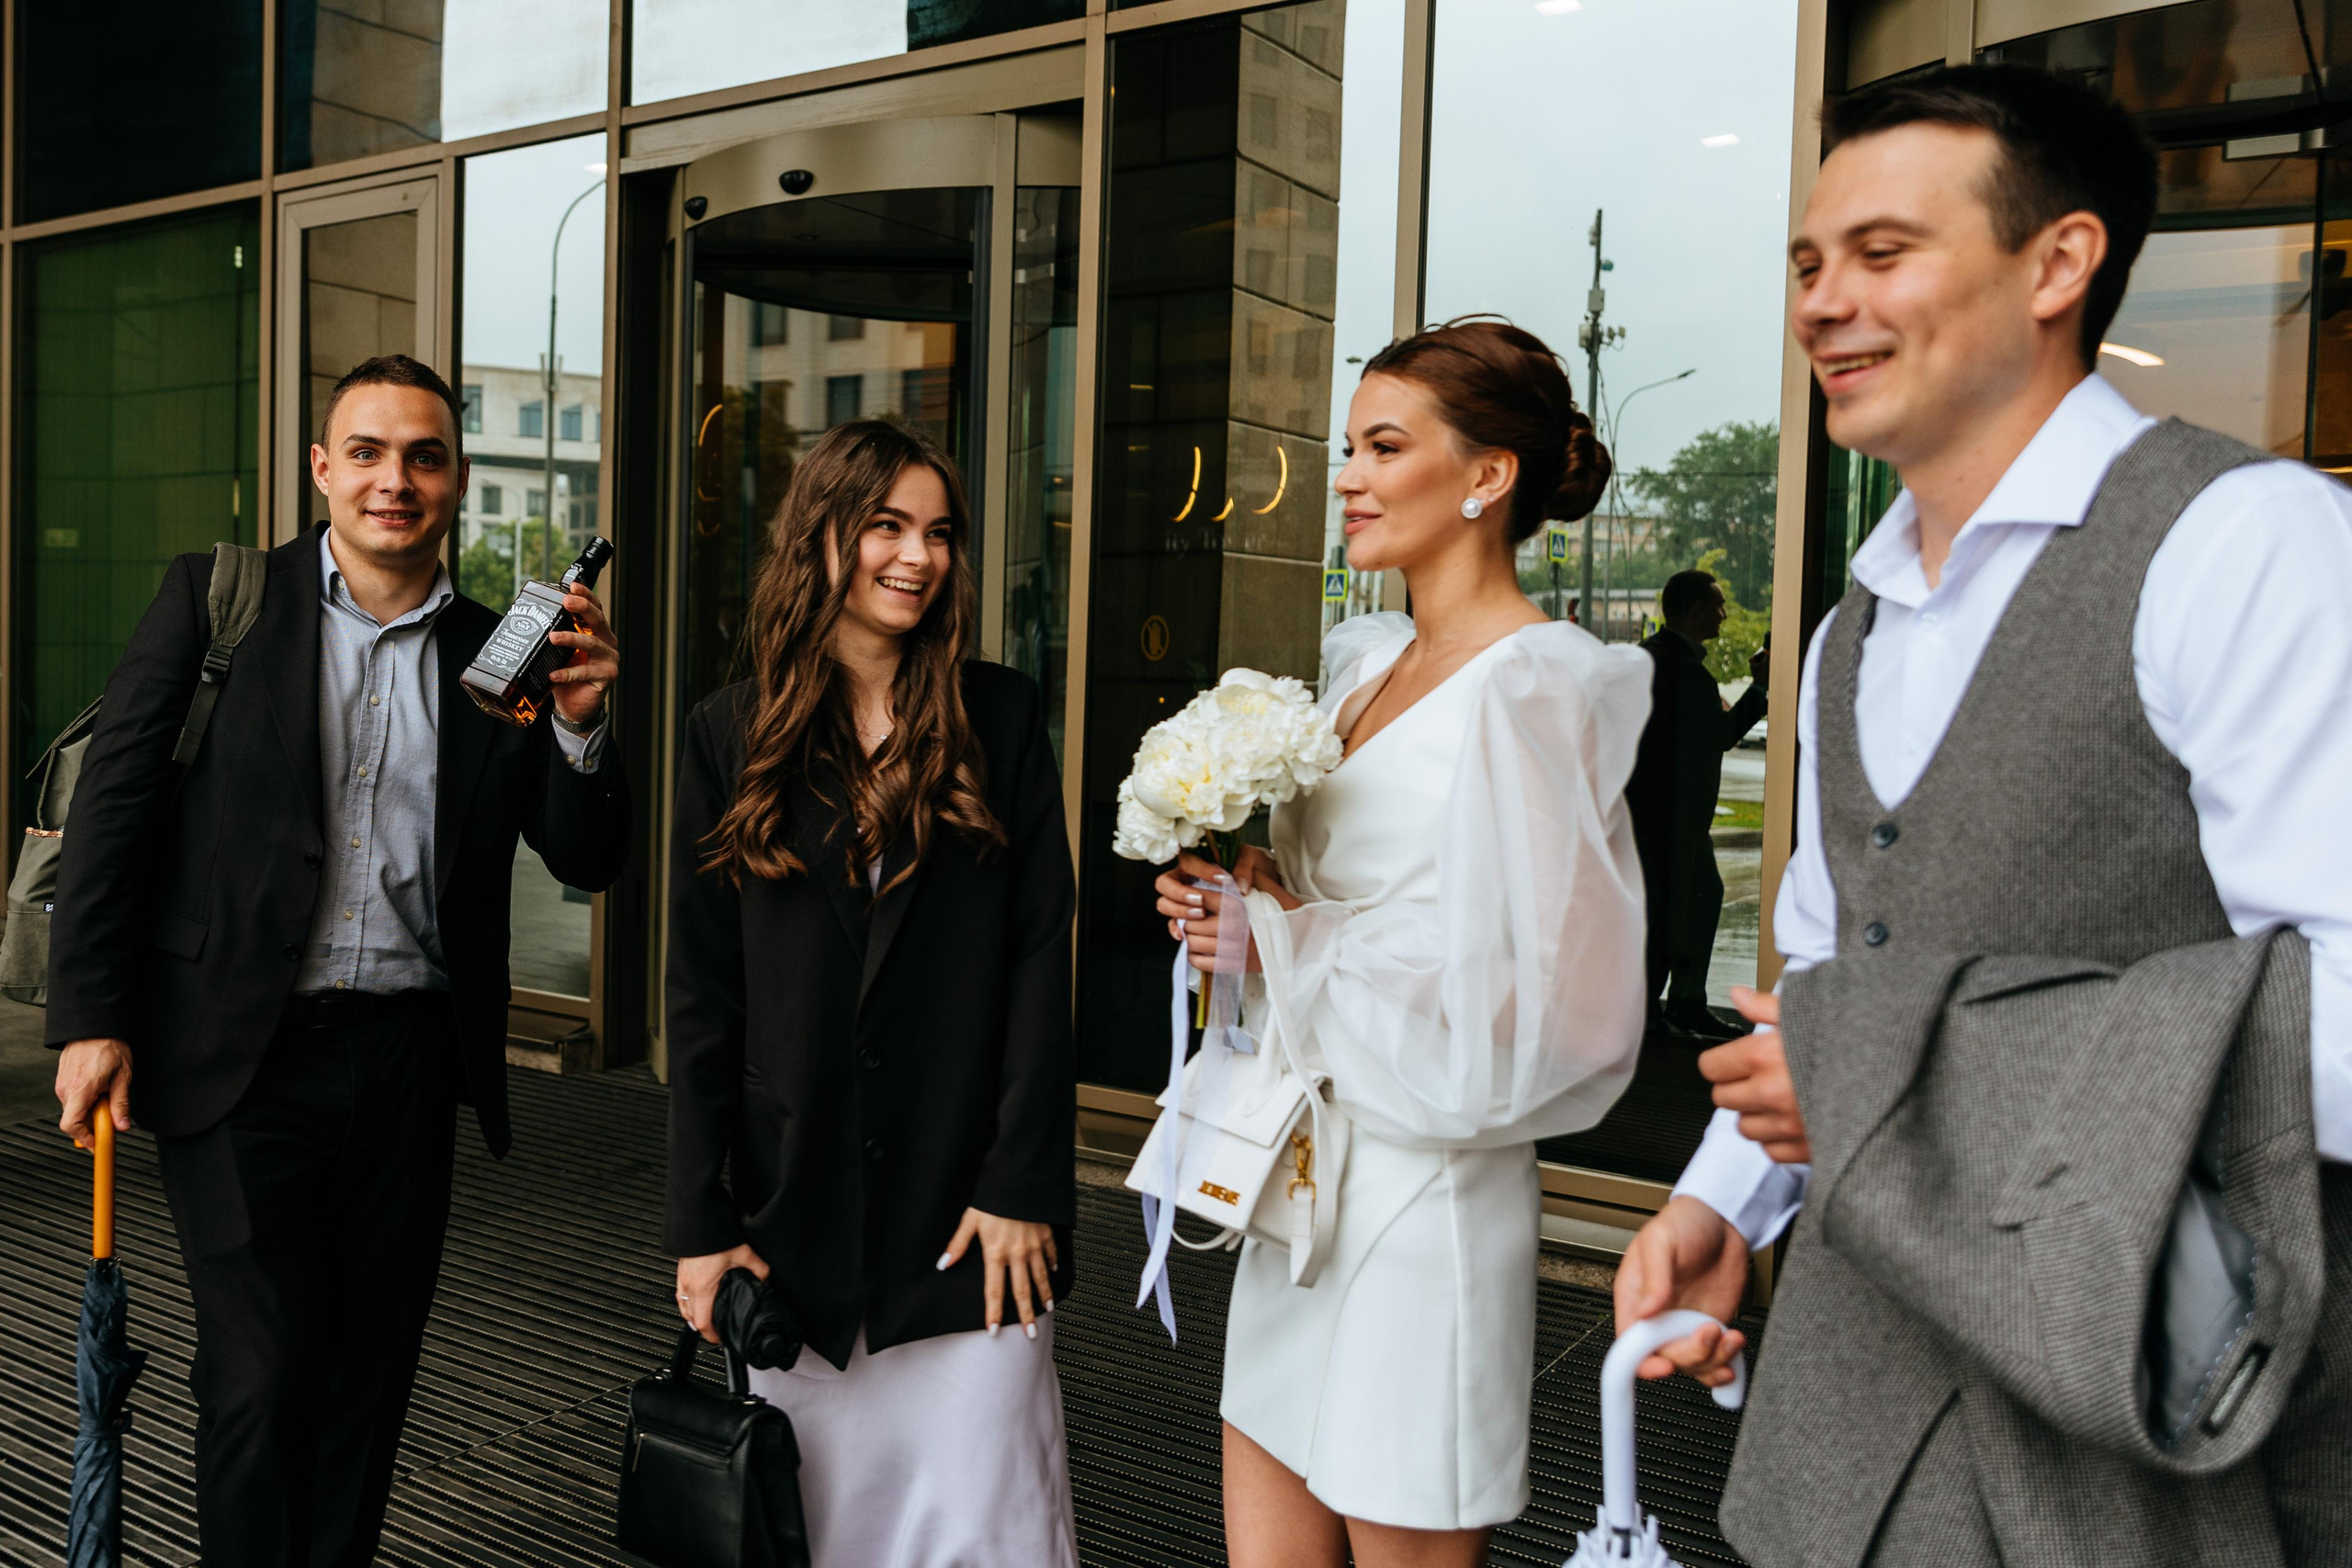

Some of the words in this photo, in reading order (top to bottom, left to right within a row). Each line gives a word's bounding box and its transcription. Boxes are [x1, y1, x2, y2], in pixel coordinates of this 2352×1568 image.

[507, 604, 530, 616] JACK
[501, 628, 530, 645] Tennessee
[496, 637, 525, 651] WHISKEY
